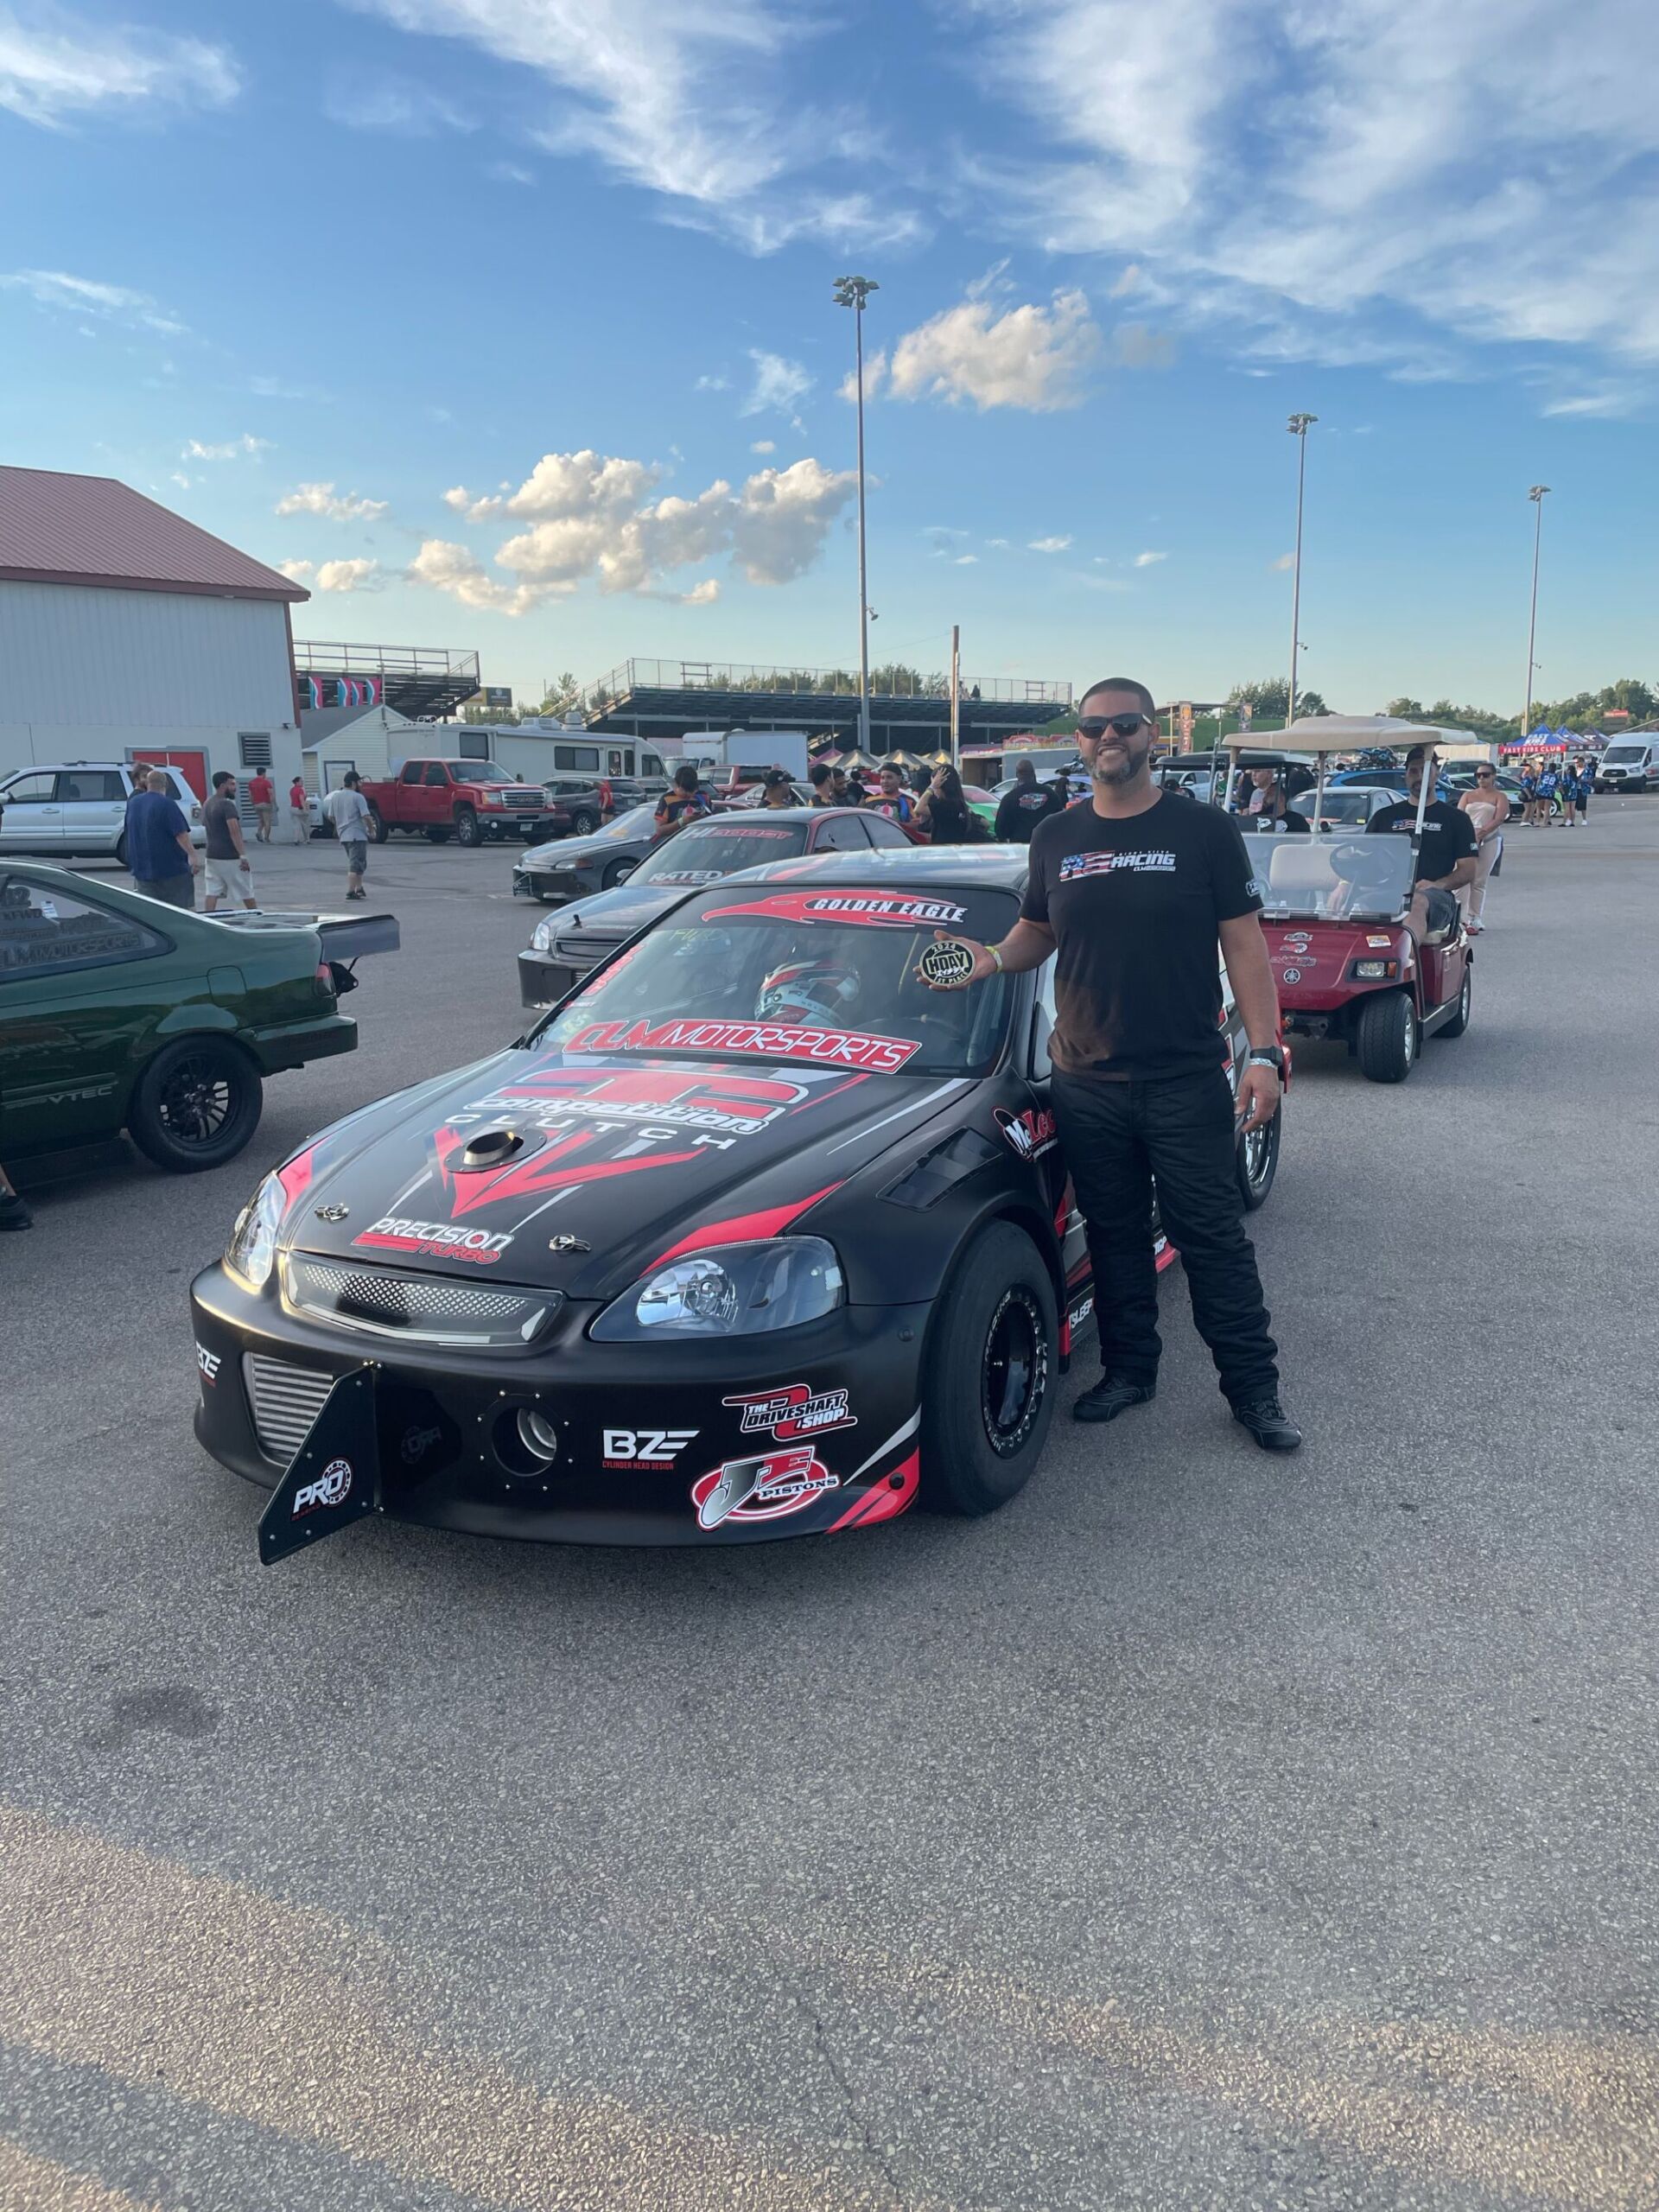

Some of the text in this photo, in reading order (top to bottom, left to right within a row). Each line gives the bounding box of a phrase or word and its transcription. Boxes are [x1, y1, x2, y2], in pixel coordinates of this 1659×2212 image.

[1542, 775, 1555, 785] 28
[649, 870, 722, 882] RATED
[814, 899, 968, 923] GOLDEN EAGLE
[931, 943, 957, 953] 2024
[928, 953, 964, 973] HDAY
[660, 1023, 912, 1068] MOTORSPORTS
[49, 1086, 112, 1103] VTEC
[444, 1114, 737, 1150] CLUTCH
[417, 1243, 501, 1264] TURBO
[747, 1403, 770, 1415] THE
[747, 1394, 844, 1427] DRIVESHAFT
[801, 1408, 845, 1429] SHOP
[603, 1430, 700, 1460] BZE
[602, 1460, 674, 1471] CYLINDER HEAD DESIGN
[293, 1470, 344, 1514] PRO
[760, 1477, 838, 1498] PISTONS
